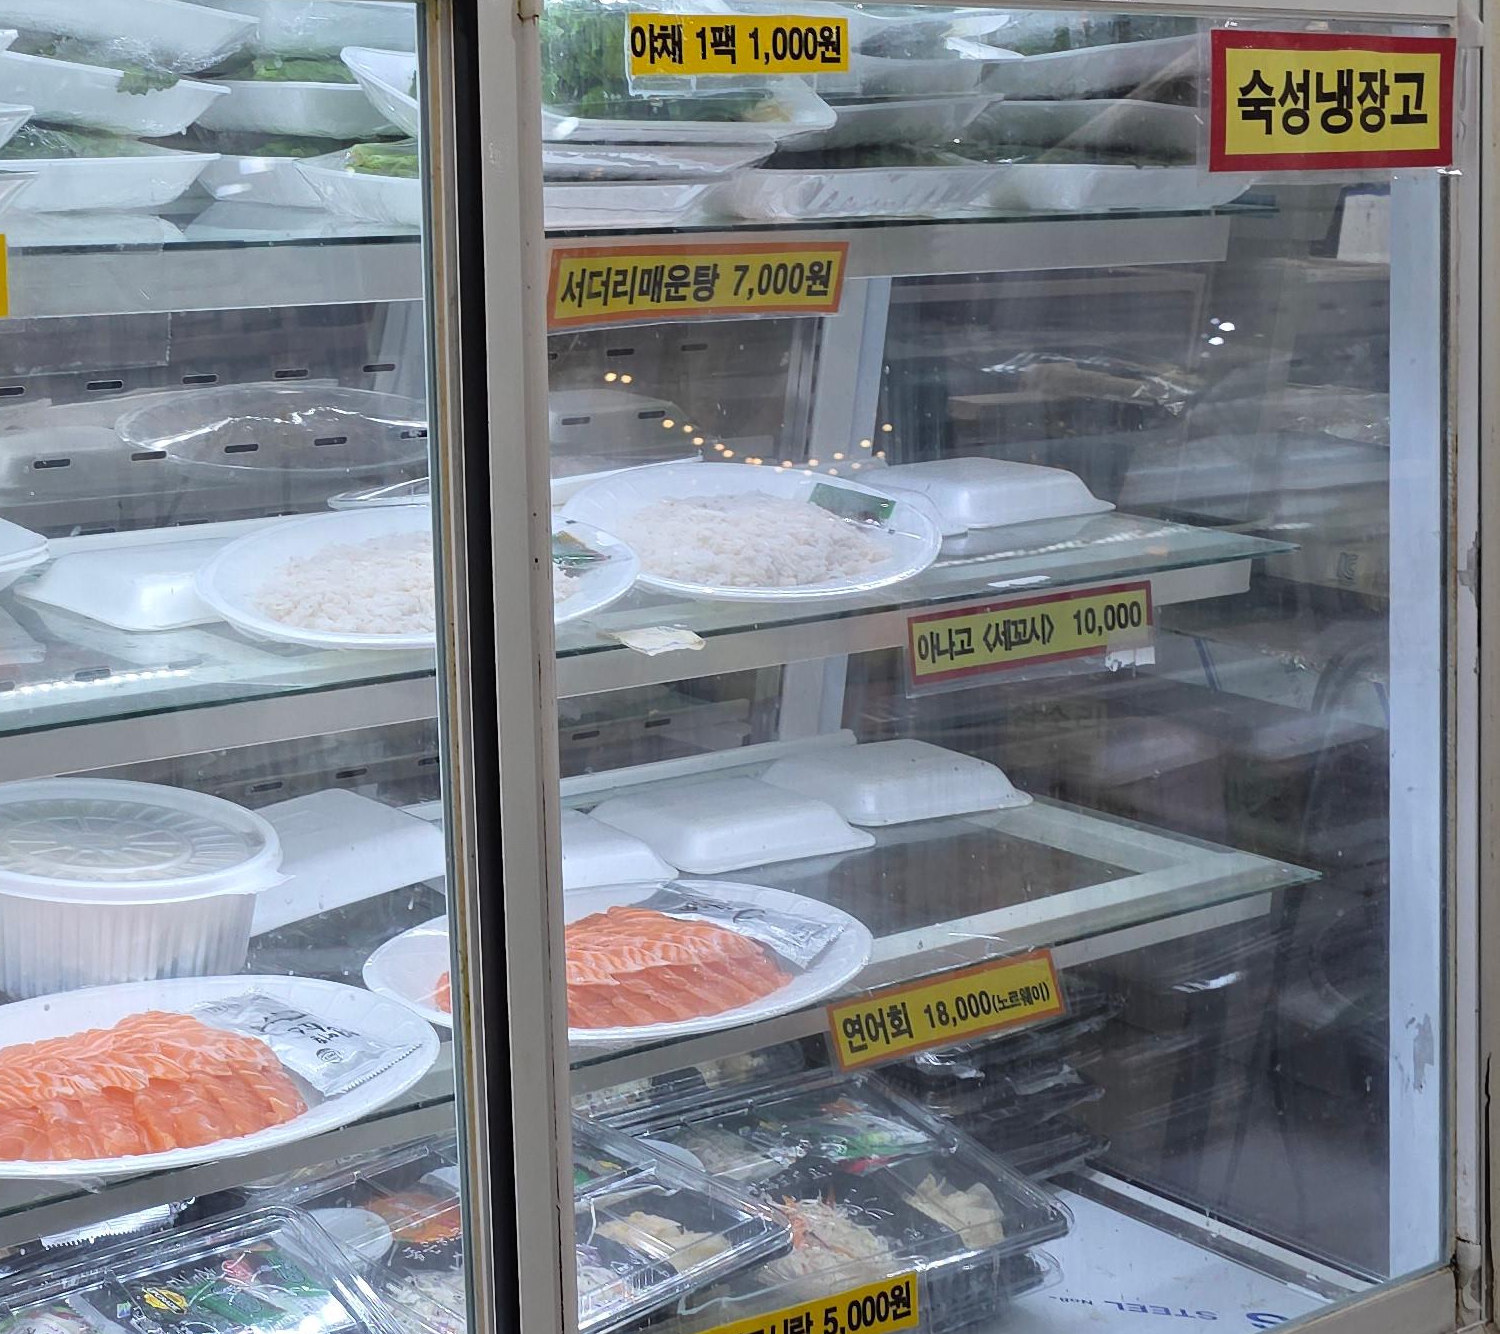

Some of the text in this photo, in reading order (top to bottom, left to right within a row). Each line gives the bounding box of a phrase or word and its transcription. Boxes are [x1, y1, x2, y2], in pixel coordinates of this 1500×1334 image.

[631, 24, 842, 65] 야채 1팩 1,000원
[1237, 68, 1428, 135] 숙성냉장고
[561, 259, 834, 308] 서더리매운탕 7,000원
[917, 627, 975, 664] 아나고
[1073, 601, 1142, 636] 10,000
[842, 978, 1051, 1053] 연어회 18,000(노르웨이)
